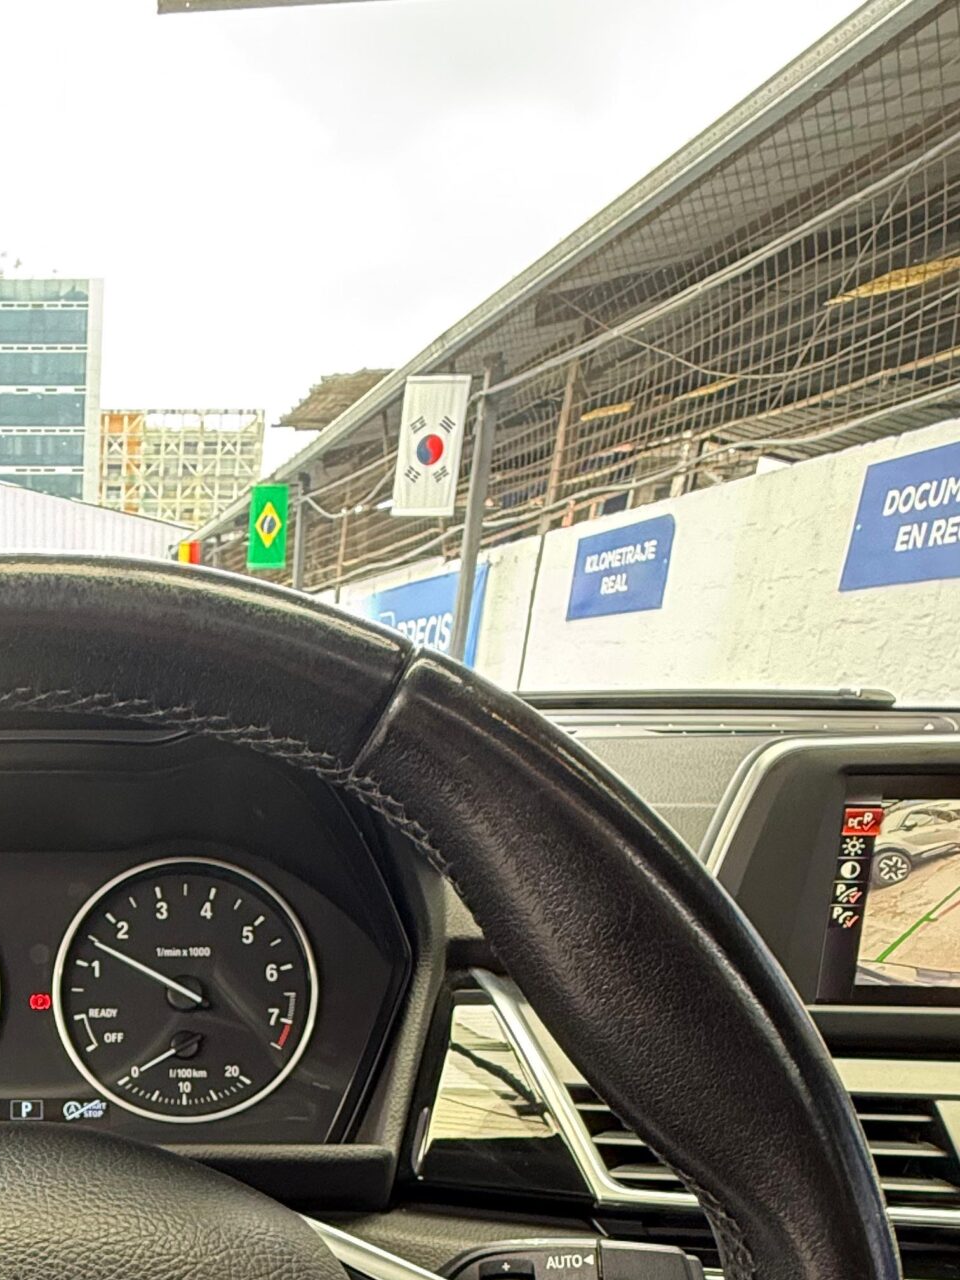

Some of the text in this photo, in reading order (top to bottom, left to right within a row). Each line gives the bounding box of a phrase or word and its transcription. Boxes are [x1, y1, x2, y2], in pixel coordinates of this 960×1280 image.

[894, 516, 960, 552] EN RE
[585, 540, 658, 573] KILOMETRAJE
[601, 573, 628, 595] REAL
[156, 902, 168, 920] 3
[200, 902, 213, 919] 4
[116, 922, 129, 939] 2
[242, 927, 254, 944] 5
[91, 961, 100, 978] 1
[265, 964, 278, 982] 6
[89, 1008, 118, 1019] READY
[268, 1008, 279, 1026] 7
[104, 1033, 123, 1043] OFF
[131, 1066, 139, 1078] 0
[224, 1065, 239, 1077] 20
[178, 1081, 191, 1093] 10
[21, 1101, 32, 1118] P
[546, 1254, 583, 1270] AUTO
